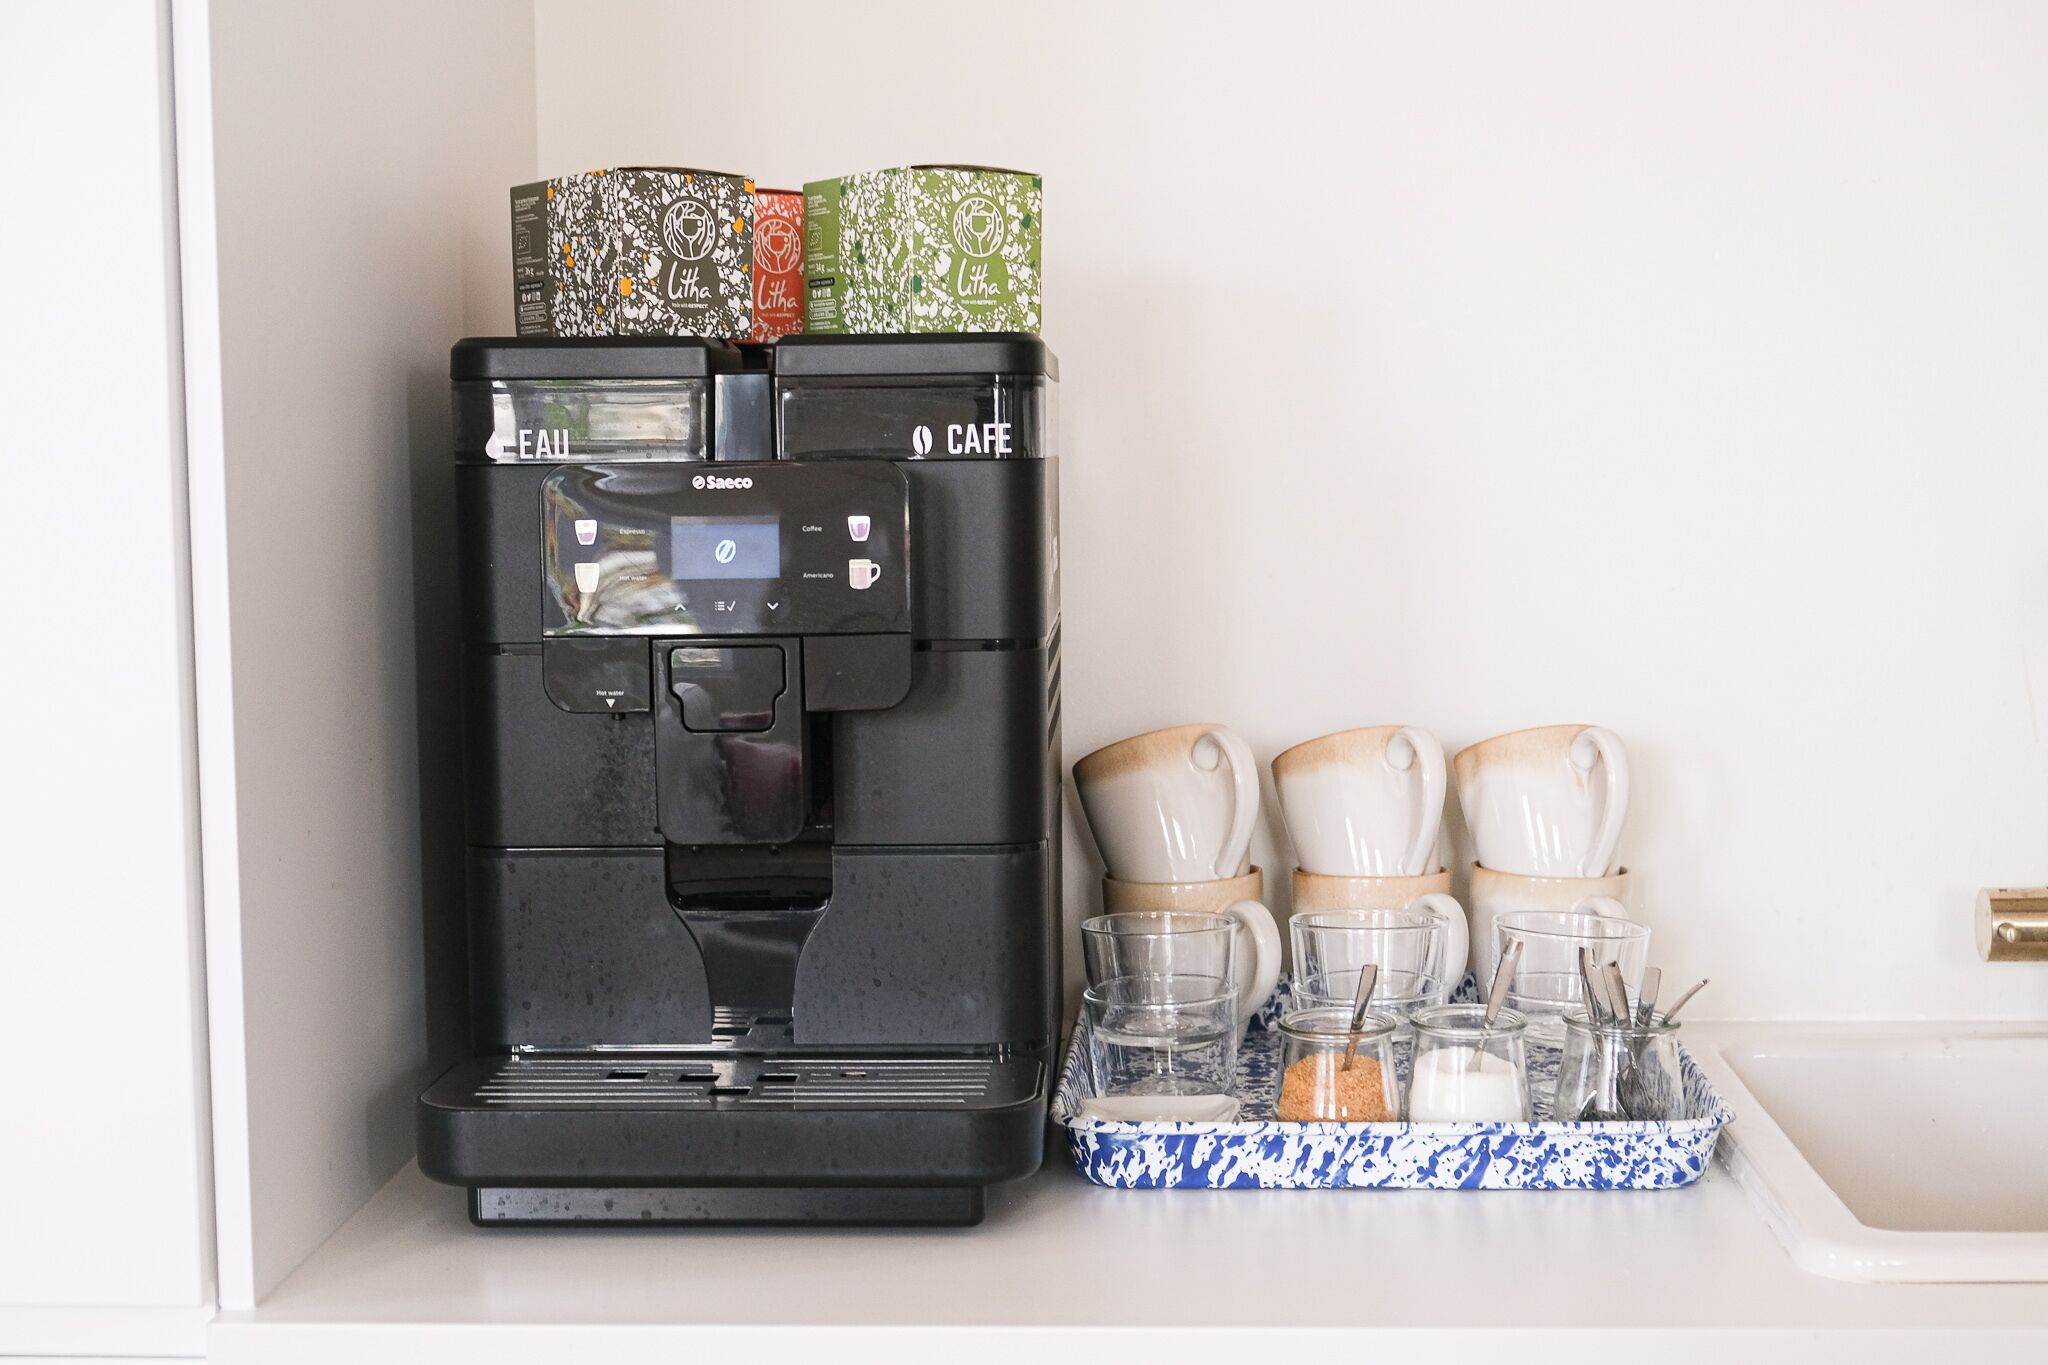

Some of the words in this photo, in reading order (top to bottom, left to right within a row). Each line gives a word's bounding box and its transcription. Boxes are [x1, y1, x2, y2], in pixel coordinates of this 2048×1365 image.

[668, 260, 712, 303] Litha
[757, 274, 799, 312] Litha
[957, 257, 1001, 300] Litha
[519, 428, 569, 459] EAU
[947, 423, 1012, 454] CAFE
[706, 475, 753, 490] Saeco
[619, 528, 646, 536] Espresso
[802, 525, 823, 533] Coffee
[803, 572, 834, 580] Americano
